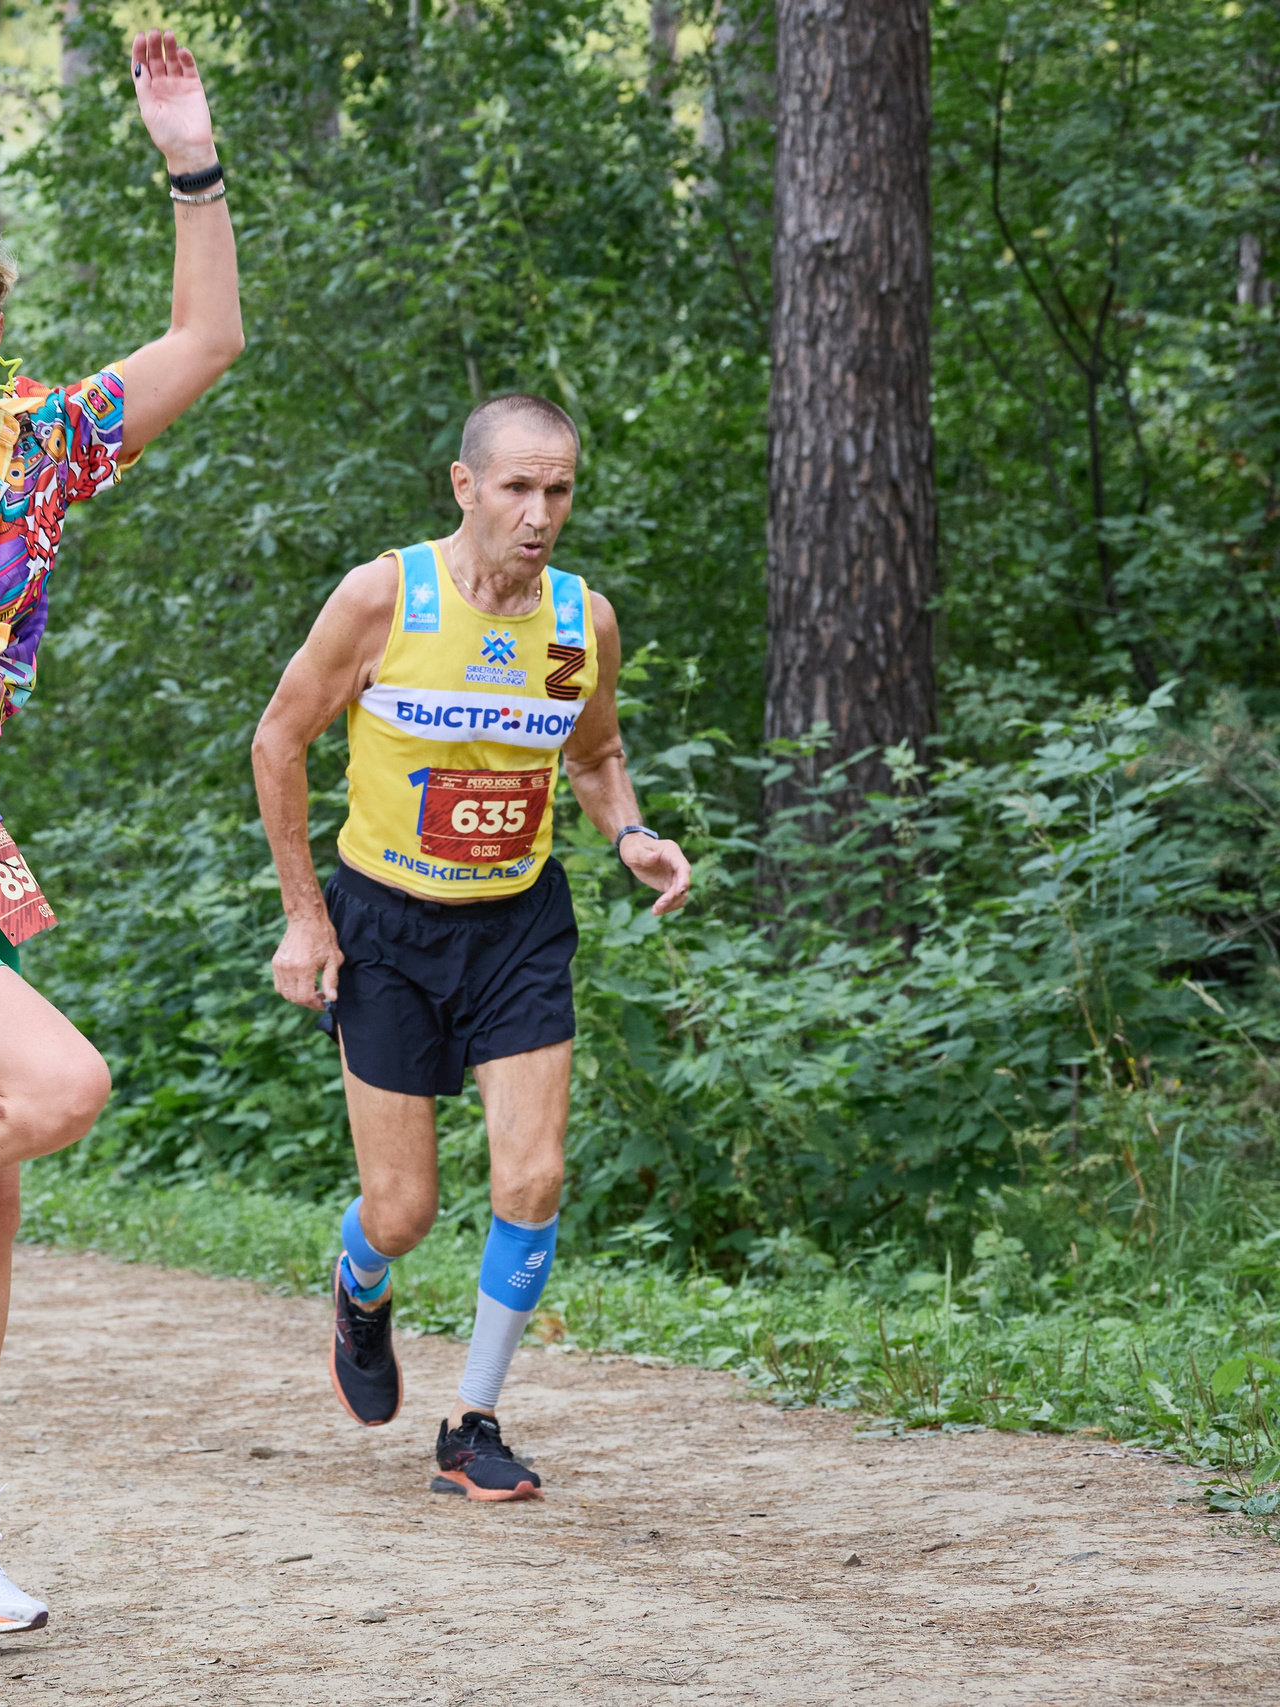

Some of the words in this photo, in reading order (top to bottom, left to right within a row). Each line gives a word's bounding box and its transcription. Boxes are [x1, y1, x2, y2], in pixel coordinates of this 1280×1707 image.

[466, 665, 504, 675] SIBERIAN
[507, 669, 527, 678] 2021
[465, 673, 526, 686] MARCIALONGA
[451, 799, 527, 834] 635
[471, 845, 480, 856] 6
